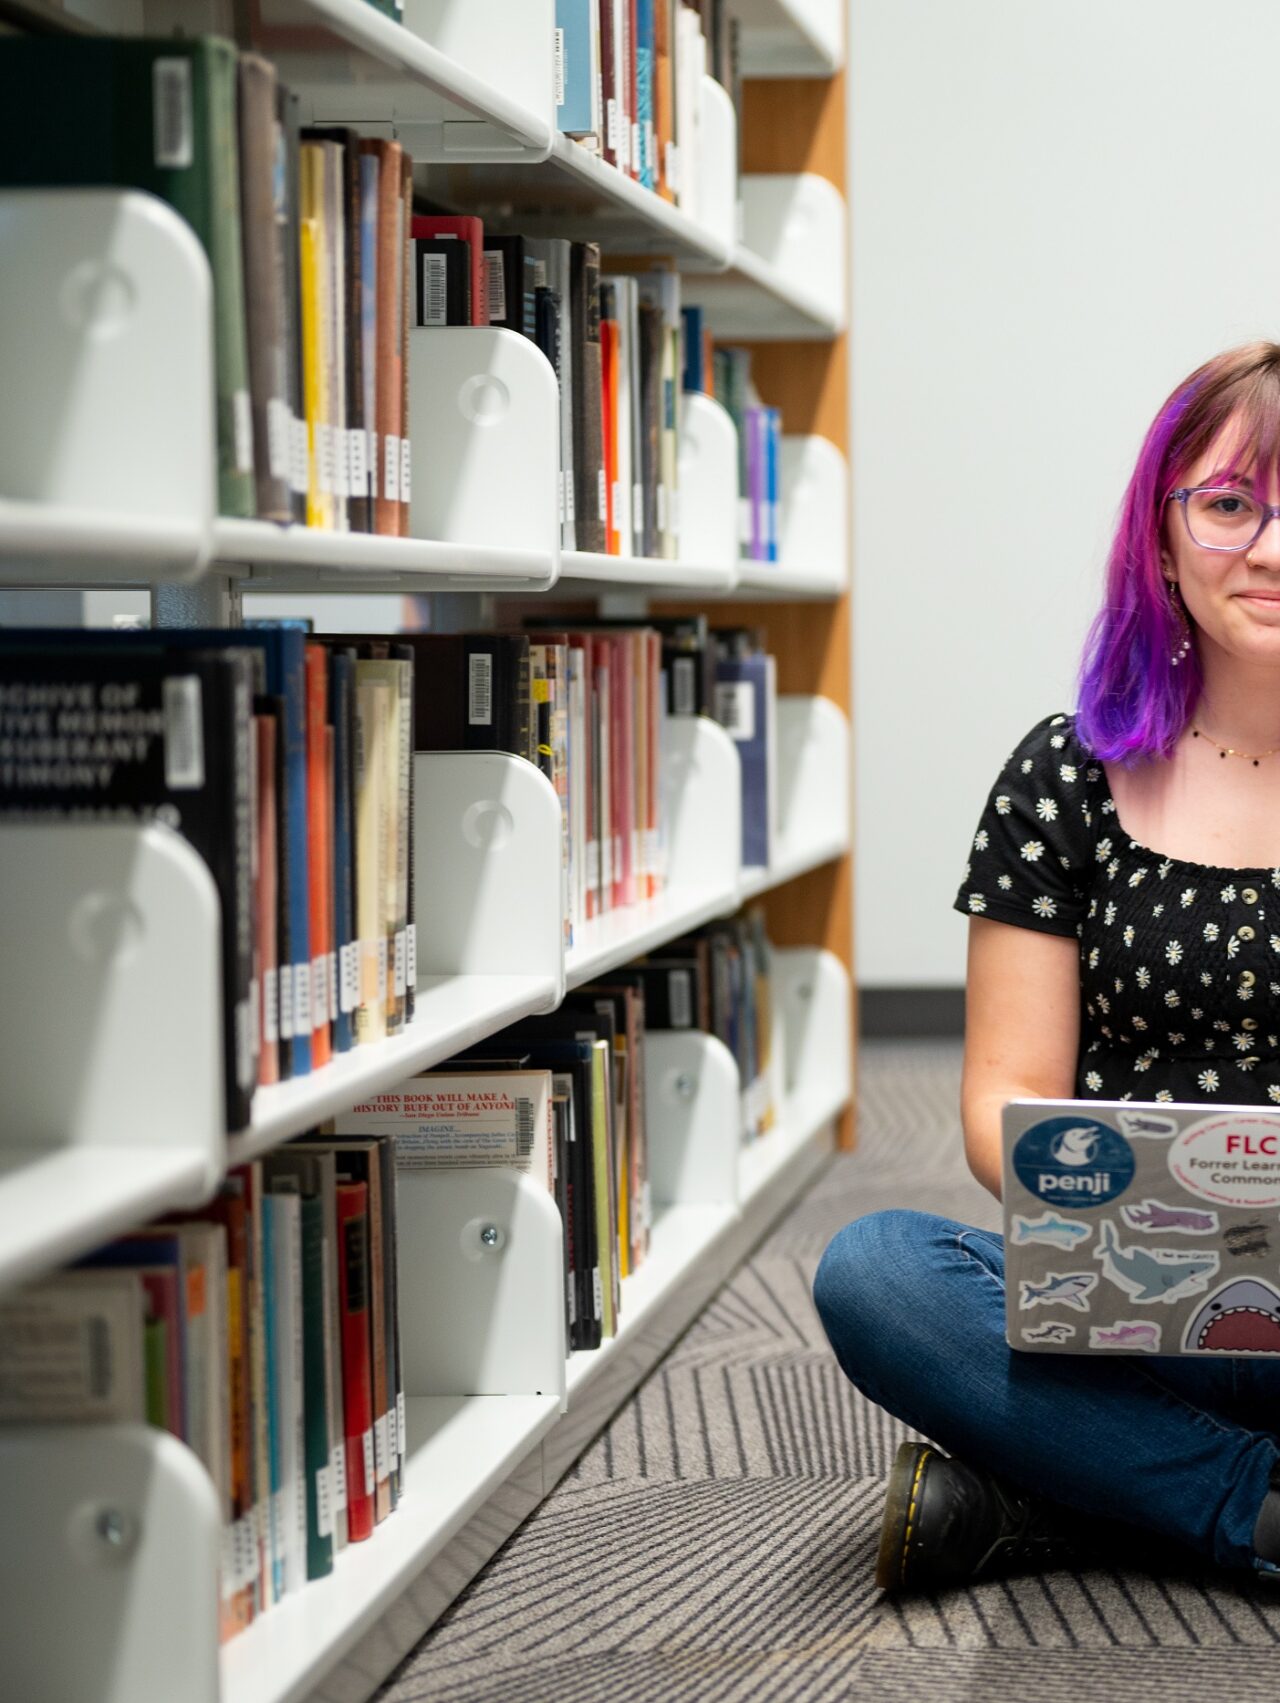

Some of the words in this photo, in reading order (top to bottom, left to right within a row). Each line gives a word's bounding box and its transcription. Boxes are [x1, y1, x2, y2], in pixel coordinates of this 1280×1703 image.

[403, 1094, 433, 1103] BOOK
[436, 1093, 465, 1102] WILL
[466, 1093, 497, 1102] MAKE
[500, 1093, 508, 1101] A
[353, 1104, 400, 1113] HISTORY
[403, 1104, 429, 1112] BUFF
[432, 1104, 455, 1112] OUT
[457, 1103, 471, 1112] OF
[1226, 1134, 1278, 1155] FLC
[1189, 1158, 1238, 1171] Forrer
[1038, 1171, 1111, 1195] penji
